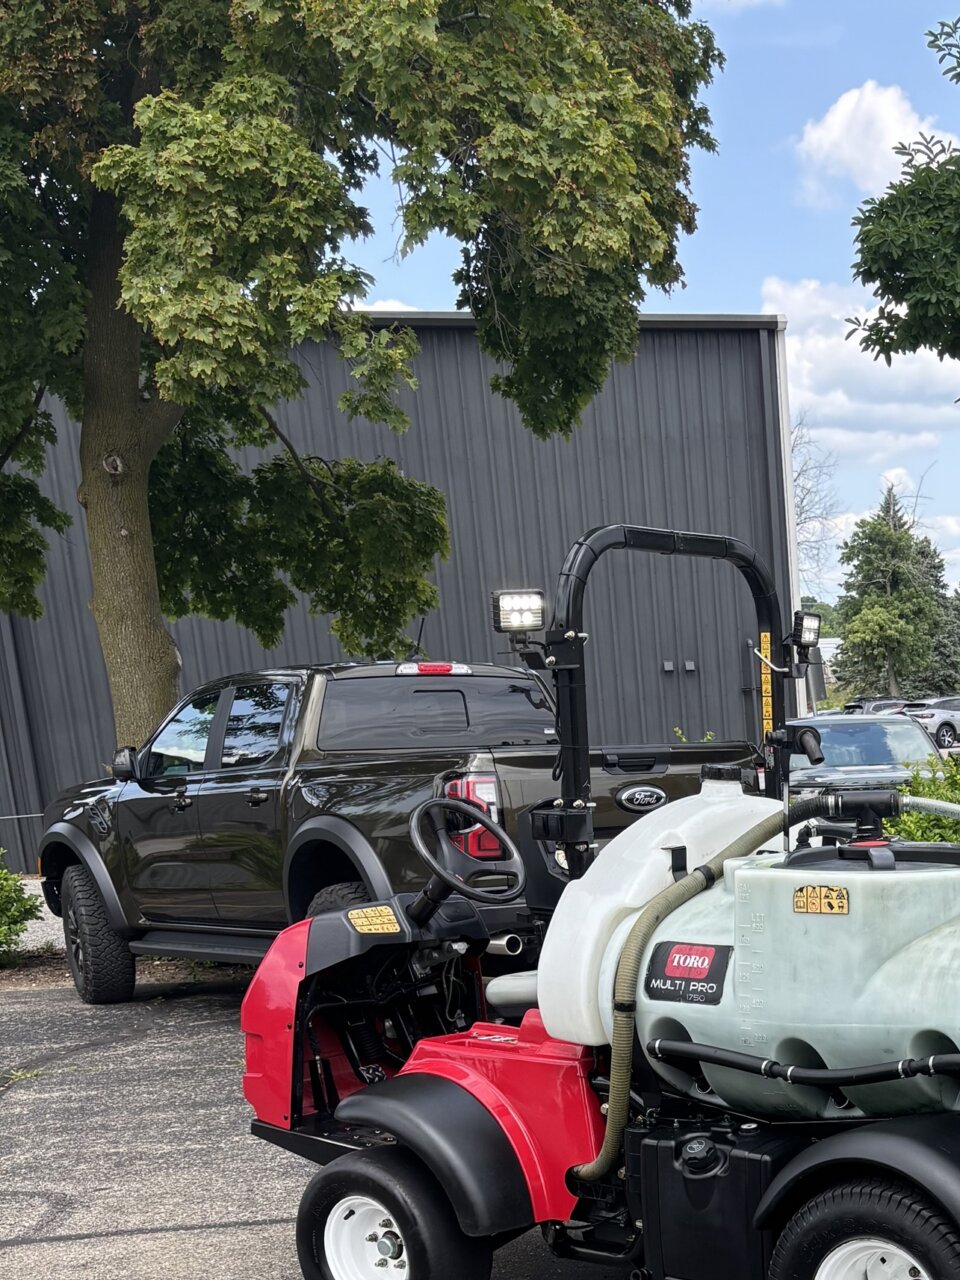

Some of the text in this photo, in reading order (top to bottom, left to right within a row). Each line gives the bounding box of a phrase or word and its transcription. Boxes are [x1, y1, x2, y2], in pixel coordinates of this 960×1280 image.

[633, 792, 657, 804] Ford
[672, 953, 709, 969] TORO
[650, 978, 717, 993] MULTI PRO
[686, 993, 706, 1002] 1750
